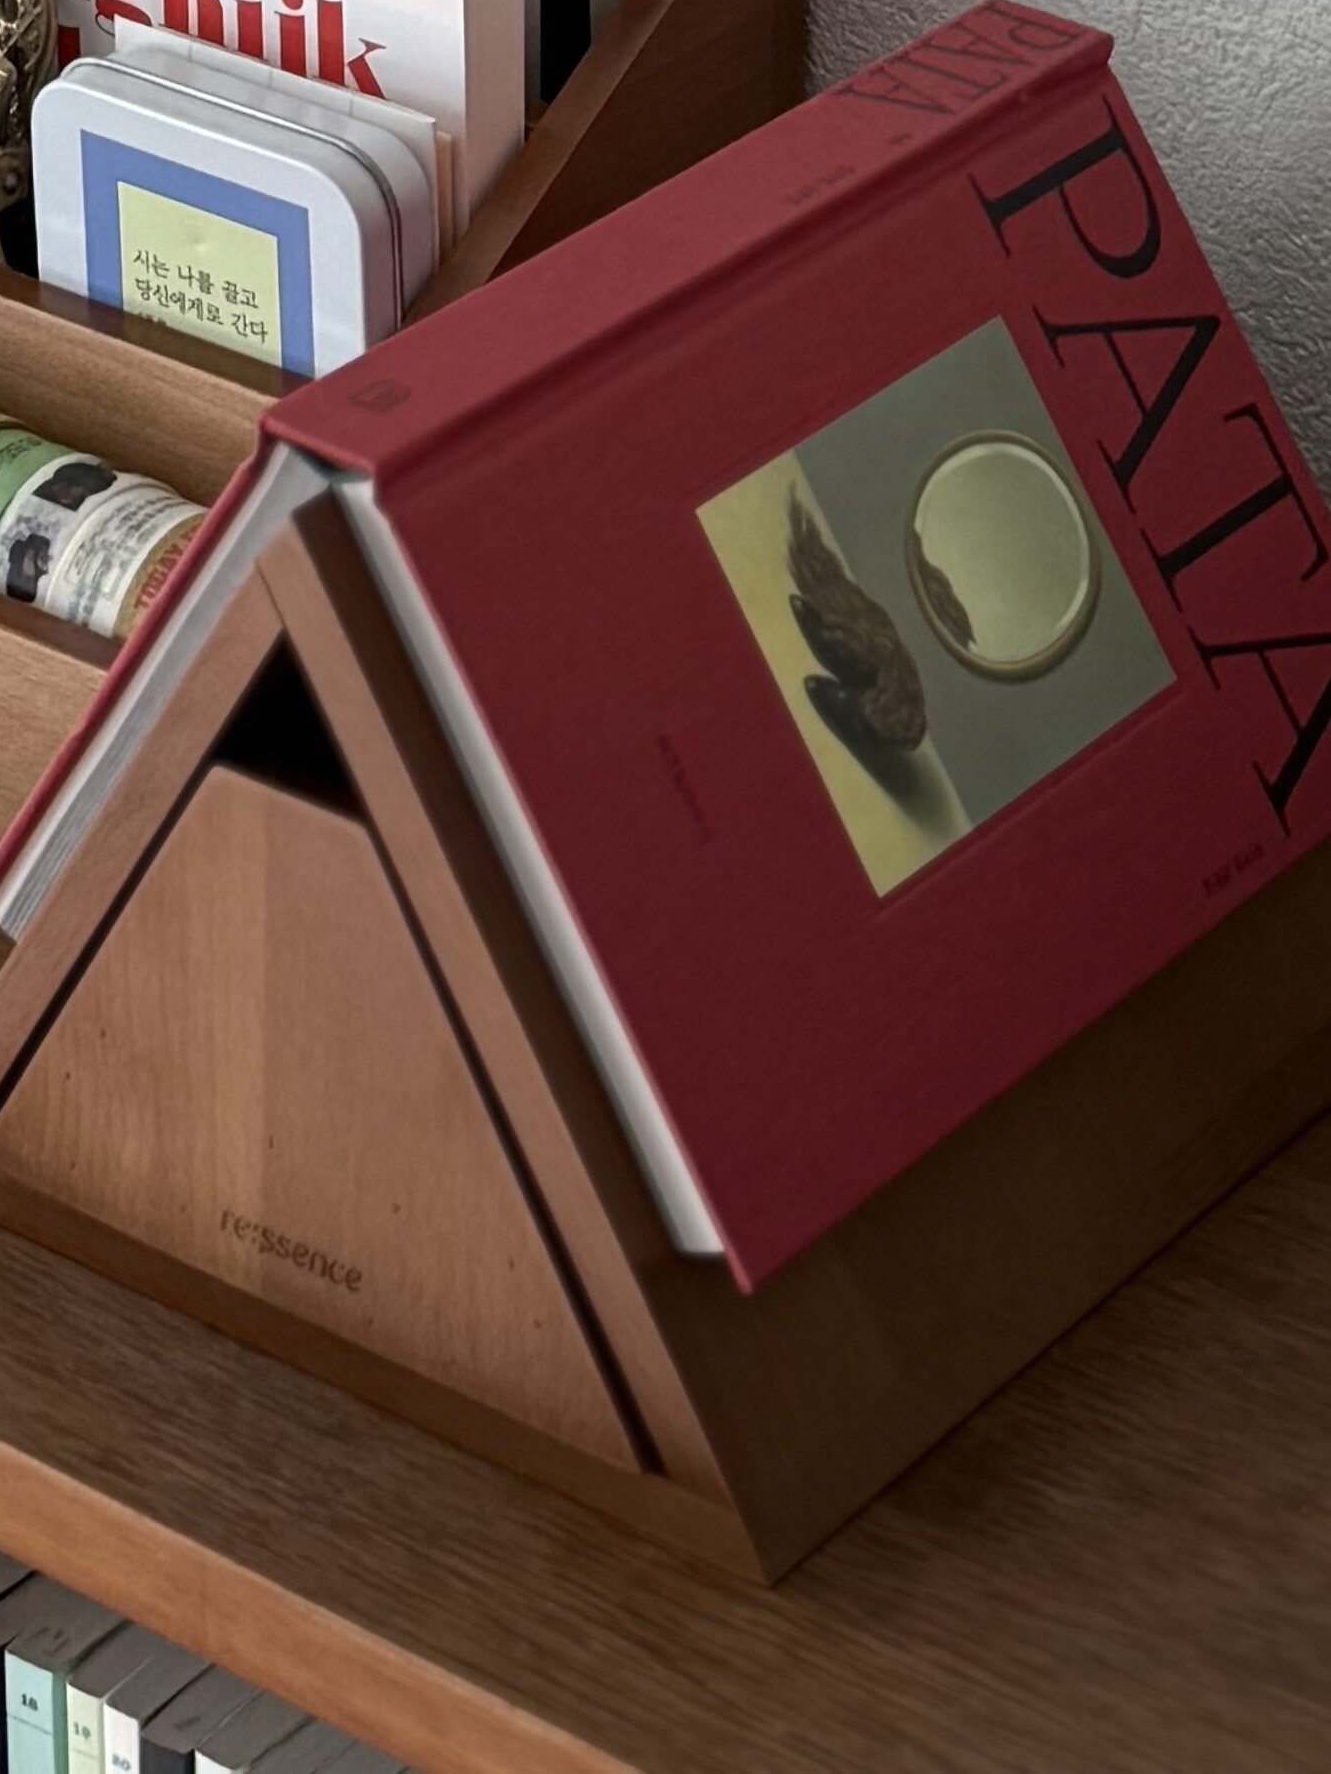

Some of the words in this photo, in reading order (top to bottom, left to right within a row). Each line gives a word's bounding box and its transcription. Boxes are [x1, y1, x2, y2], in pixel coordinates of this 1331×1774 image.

[132, 250, 171, 280] 시는
[177, 264, 216, 296] 나를
[221, 279, 260, 309] 끌고
[135, 277, 225, 326] 당신에게로
[230, 312, 269, 345] 간다
[969, 93, 1331, 838] PATA
[219, 1209, 364, 1293] re:ssence
